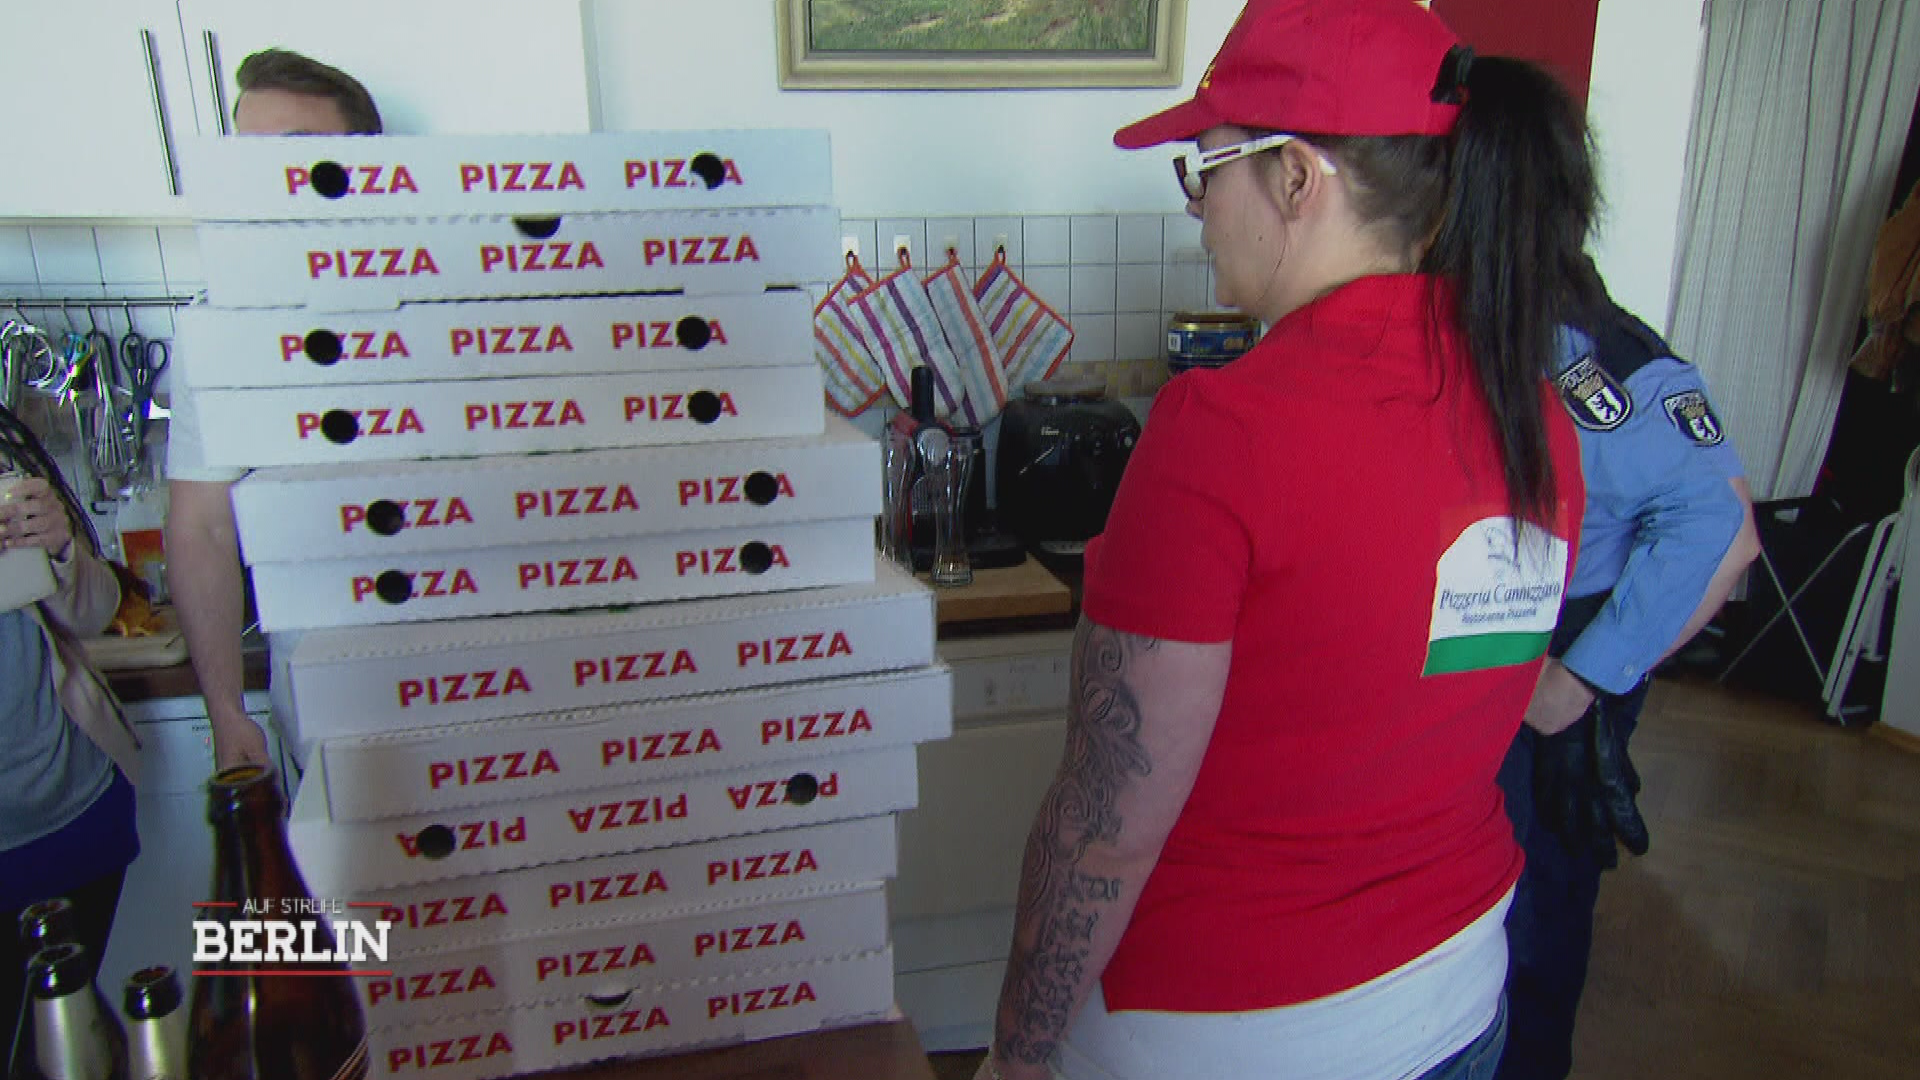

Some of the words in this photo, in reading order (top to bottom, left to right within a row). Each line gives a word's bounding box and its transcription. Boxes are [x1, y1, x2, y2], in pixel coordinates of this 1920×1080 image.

[285, 165, 418, 193] PZA
[460, 162, 584, 192] PIZZA
[625, 159, 742, 187] PIZA
[307, 248, 437, 278] PIZZA
[480, 241, 603, 273] PIZZA
[644, 236, 759, 266] PIZZA
[281, 331, 408, 361] PZA
[450, 324, 572, 355] PIZZA
[612, 321, 727, 349] PIZA
[297, 400, 424, 436] PZA
[465, 399, 585, 430] PIZZA
[624, 392, 738, 421] PIZA
[340, 497, 473, 532] PZA
[515, 485, 638, 519] PIZZA
[678, 473, 795, 506] PIZA
[352, 568, 477, 601] PZA
[518, 556, 637, 588] PIZZA
[676, 545, 789, 575] PIZA
[1440, 588, 1492, 610] Pizzeria
[398, 667, 531, 706] PIZZA
[574, 649, 697, 686] PIZZA
[737, 631, 852, 667] PIZZA
[429, 748, 557, 789] PIZZA
[602, 728, 721, 765] PIZZA
[761, 709, 871, 744] PIZZA
[396, 816, 527, 858] PIZA
[567, 794, 689, 833] PIZZA
[381, 893, 509, 930] PIZZA
[549, 869, 667, 907] PIZZA
[707, 848, 818, 884] PIZZA
[368, 965, 496, 1007] PIZZA
[536, 942, 656, 981] PIZZA
[695, 920, 805, 956] PIZZA
[388, 1031, 513, 1073] PIZZA
[553, 1006, 671, 1044] PIZZA
[707, 981, 817, 1018] PIZZA
